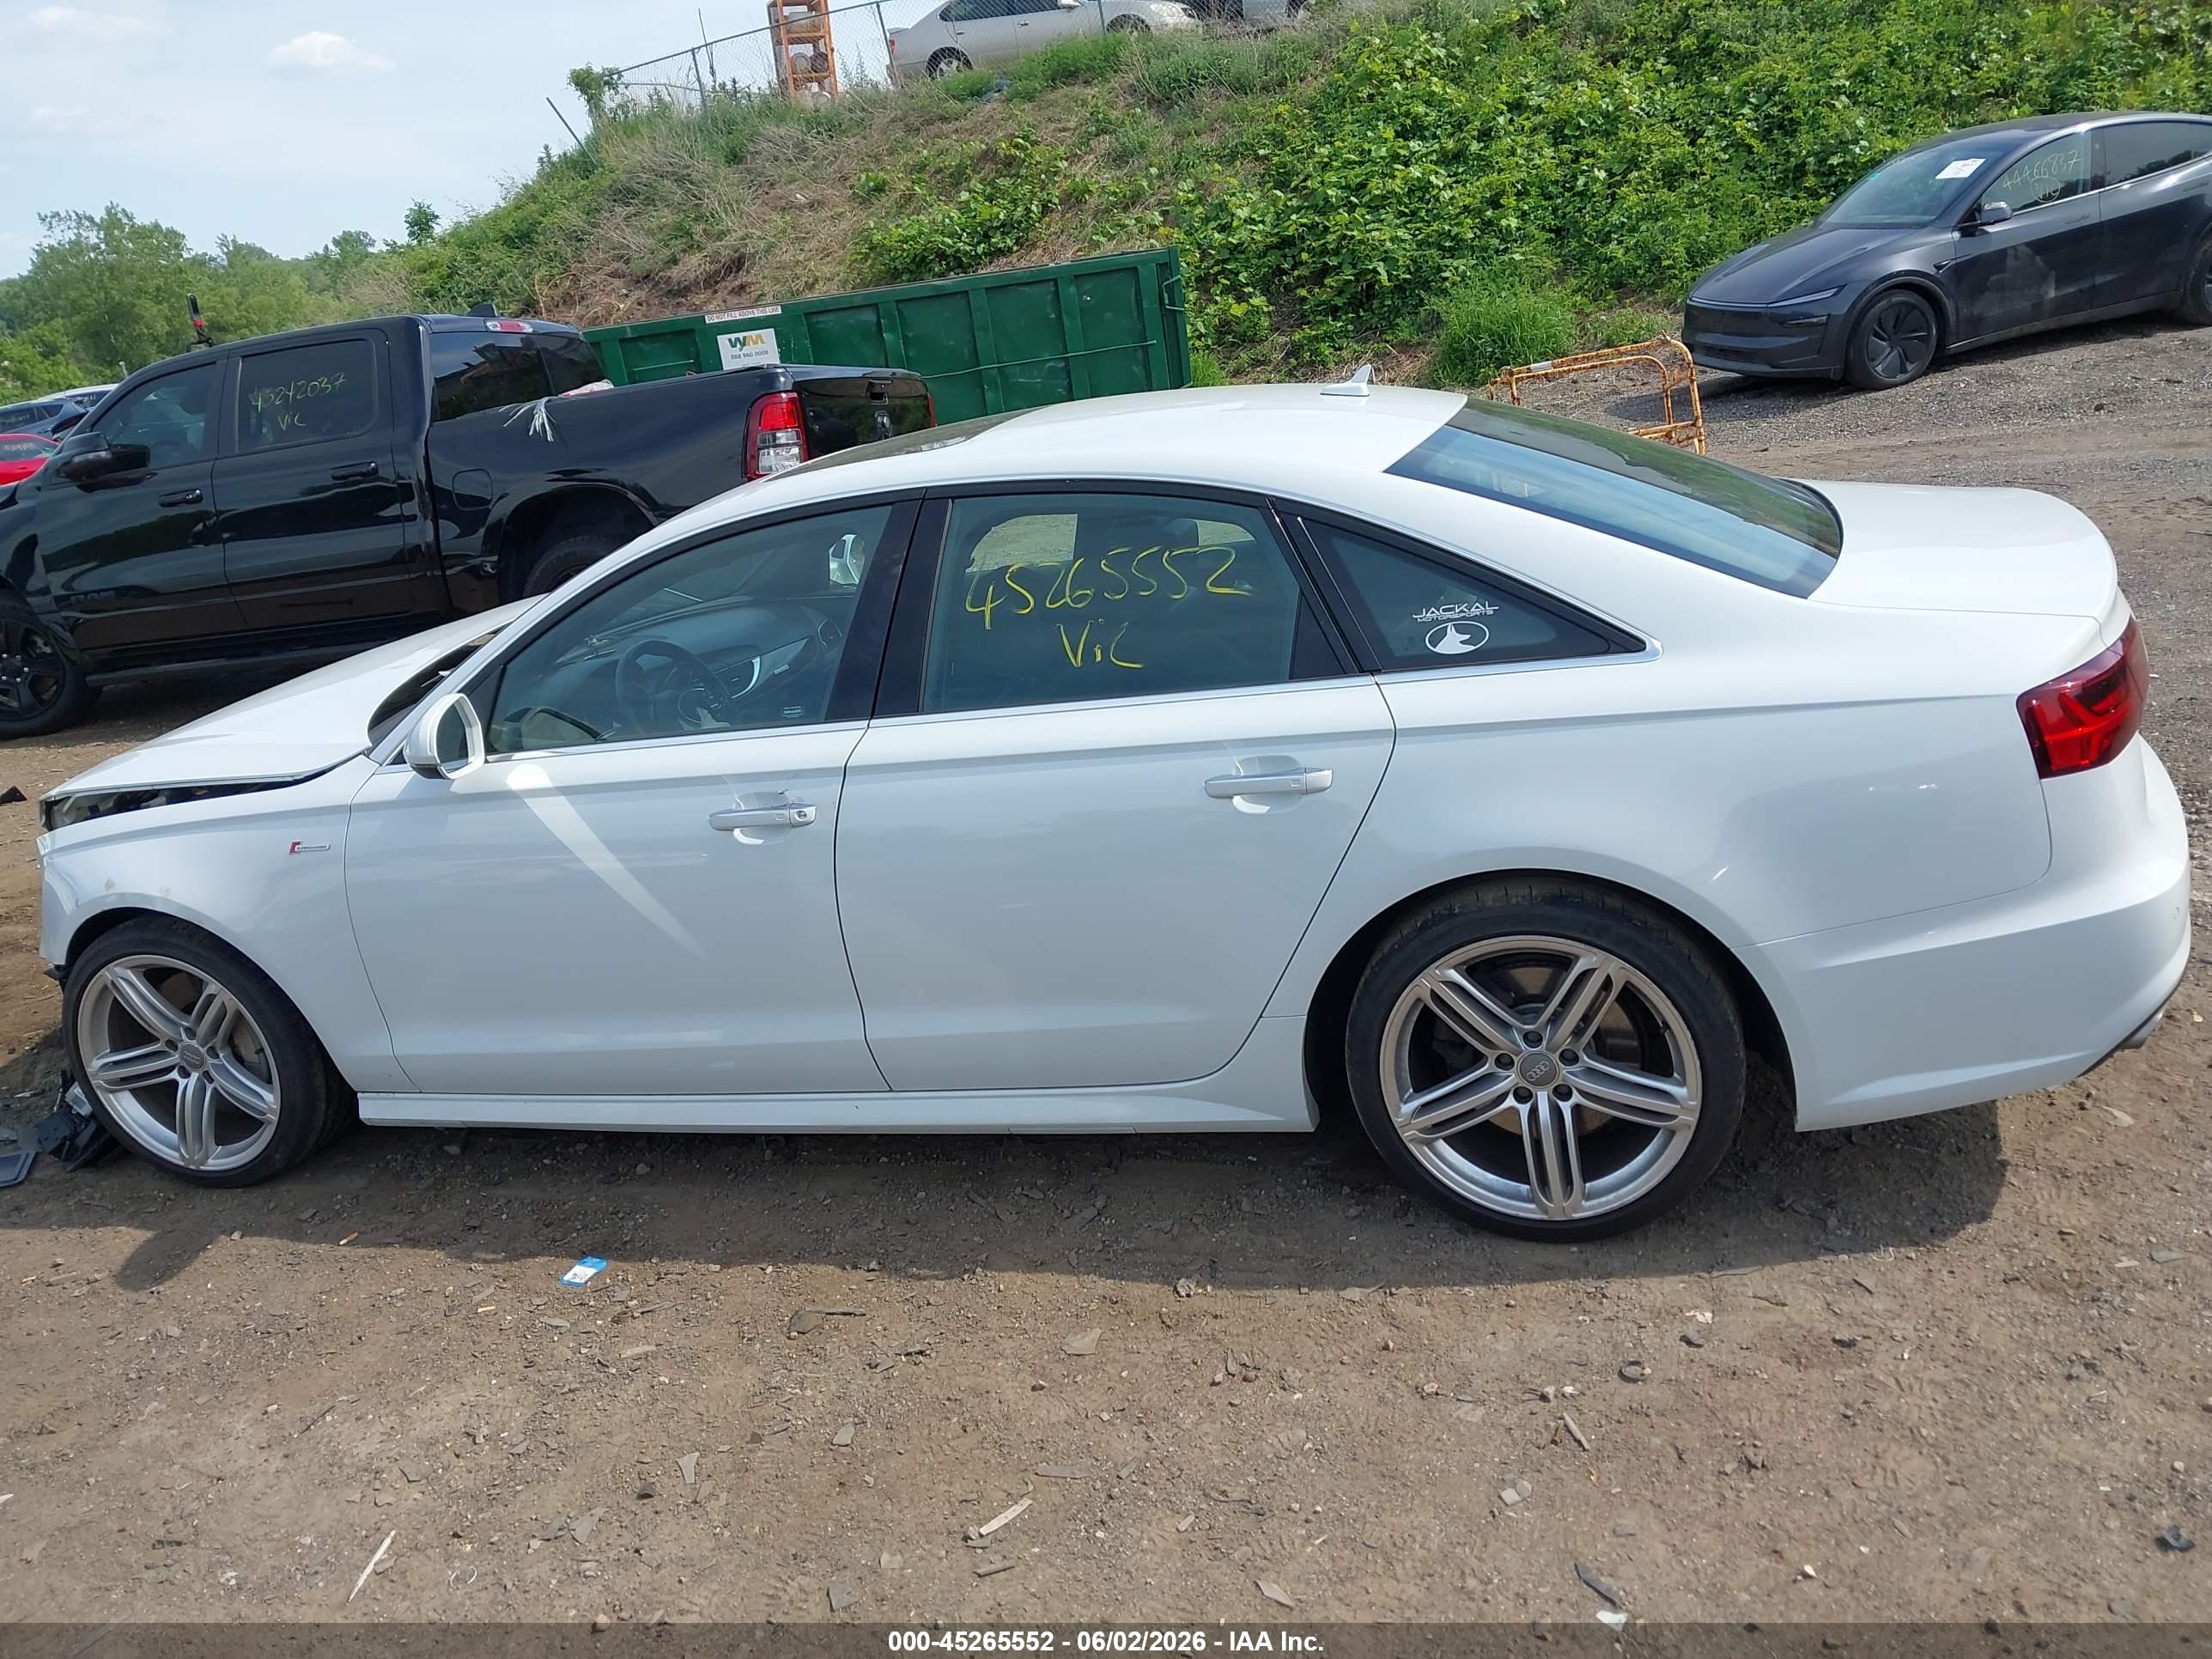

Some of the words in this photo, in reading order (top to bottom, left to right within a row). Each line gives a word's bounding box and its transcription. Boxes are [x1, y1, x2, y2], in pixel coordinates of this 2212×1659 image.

[715, 313, 726, 321] NOT
[726, 311, 738, 319] FILL
[738, 309, 756, 318] ABOVE
[768, 306, 781, 314] LINE
[727, 333, 767, 352] WM
[965, 544, 1255, 630] 45265552
[1412, 600, 1499, 618] JACKAL
[1417, 609, 1494, 623] MOTORSPORTS
